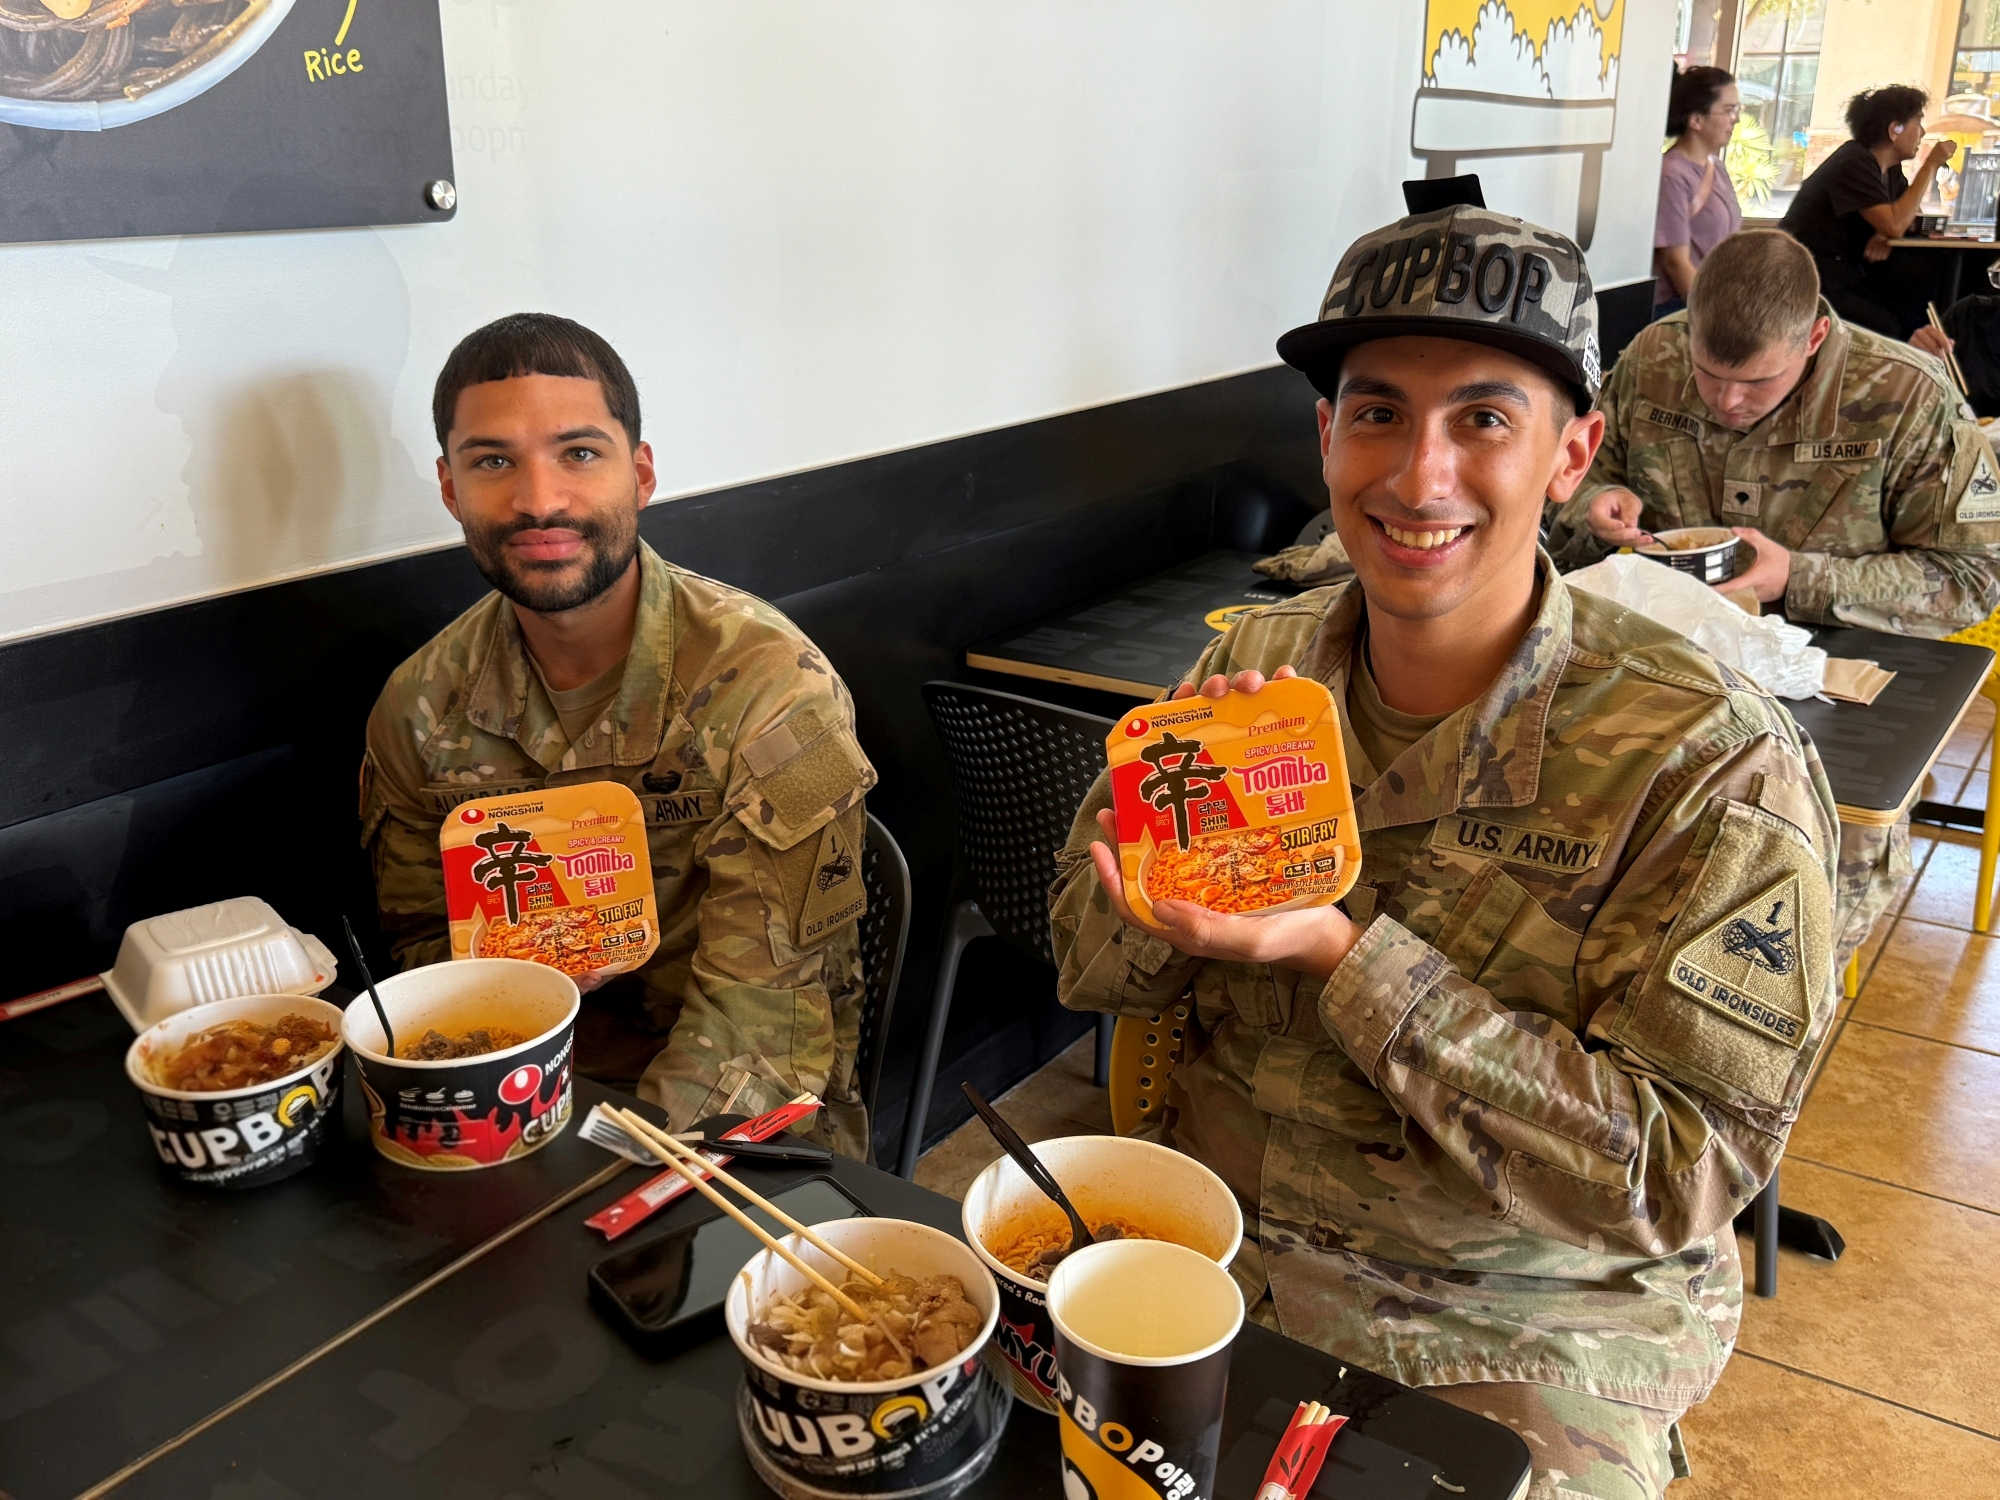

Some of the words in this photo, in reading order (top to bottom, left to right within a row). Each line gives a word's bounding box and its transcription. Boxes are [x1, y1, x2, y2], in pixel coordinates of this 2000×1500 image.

[304, 48, 363, 83] Rice
[1343, 232, 1551, 324] CUPBOP
[1650, 408, 1699, 435] BERNARD
[1812, 444, 1832, 459] U.S.
[1834, 442, 1869, 458] ARMY
[1959, 511, 1974, 520] OLD
[1151, 710, 1214, 729] NONGSHIM
[1248, 716, 1305, 737] Premium
[1244, 745, 1272, 759] SPICY
[1281, 740, 1316, 752] CREAMY
[1232, 755, 1327, 794] Toomba
[1139, 731, 1229, 853] 辛
[488, 805, 544, 819] NONGSHIM
[656, 795, 702, 822] ARMY
[1198, 800, 1227, 815] 라면
[1265, 790, 1306, 817] 툼바
[571, 814, 618, 830] Premium
[1156, 819, 1170, 827] SPICY
[1200, 814, 1228, 827] SHIN
[1201, 823, 1229, 833] RAMYUN
[568, 838, 590, 848] SPICY
[591, 837, 597, 845] &
[597, 835, 625, 845] CREAMY
[830, 835, 838, 854] 1
[1280, 831, 1310, 850] STIR
[1312, 818, 1338, 844] FRY
[1457, 820, 1503, 853] U.S.
[1512, 833, 1598, 867] ARMY
[472, 821, 553, 926] 辛
[557, 847, 634, 878] Toomba
[584, 875, 617, 898] 툼바
[1292, 888, 1306, 897] WITH
[1307, 886, 1325, 895] SAUCE
[1313, 875, 1340, 886] NOODLES
[529, 894, 553, 906] SHIN
[598, 906, 623, 925] STIR
[624, 899, 644, 920] FRY
[806, 922, 823, 937] OLD
[826, 899, 863, 928] IRONSIDES
[1765, 900, 1785, 926] 1
[1676, 966, 1708, 993] OLD
[1710, 986, 1798, 1038] IRONSIDES
